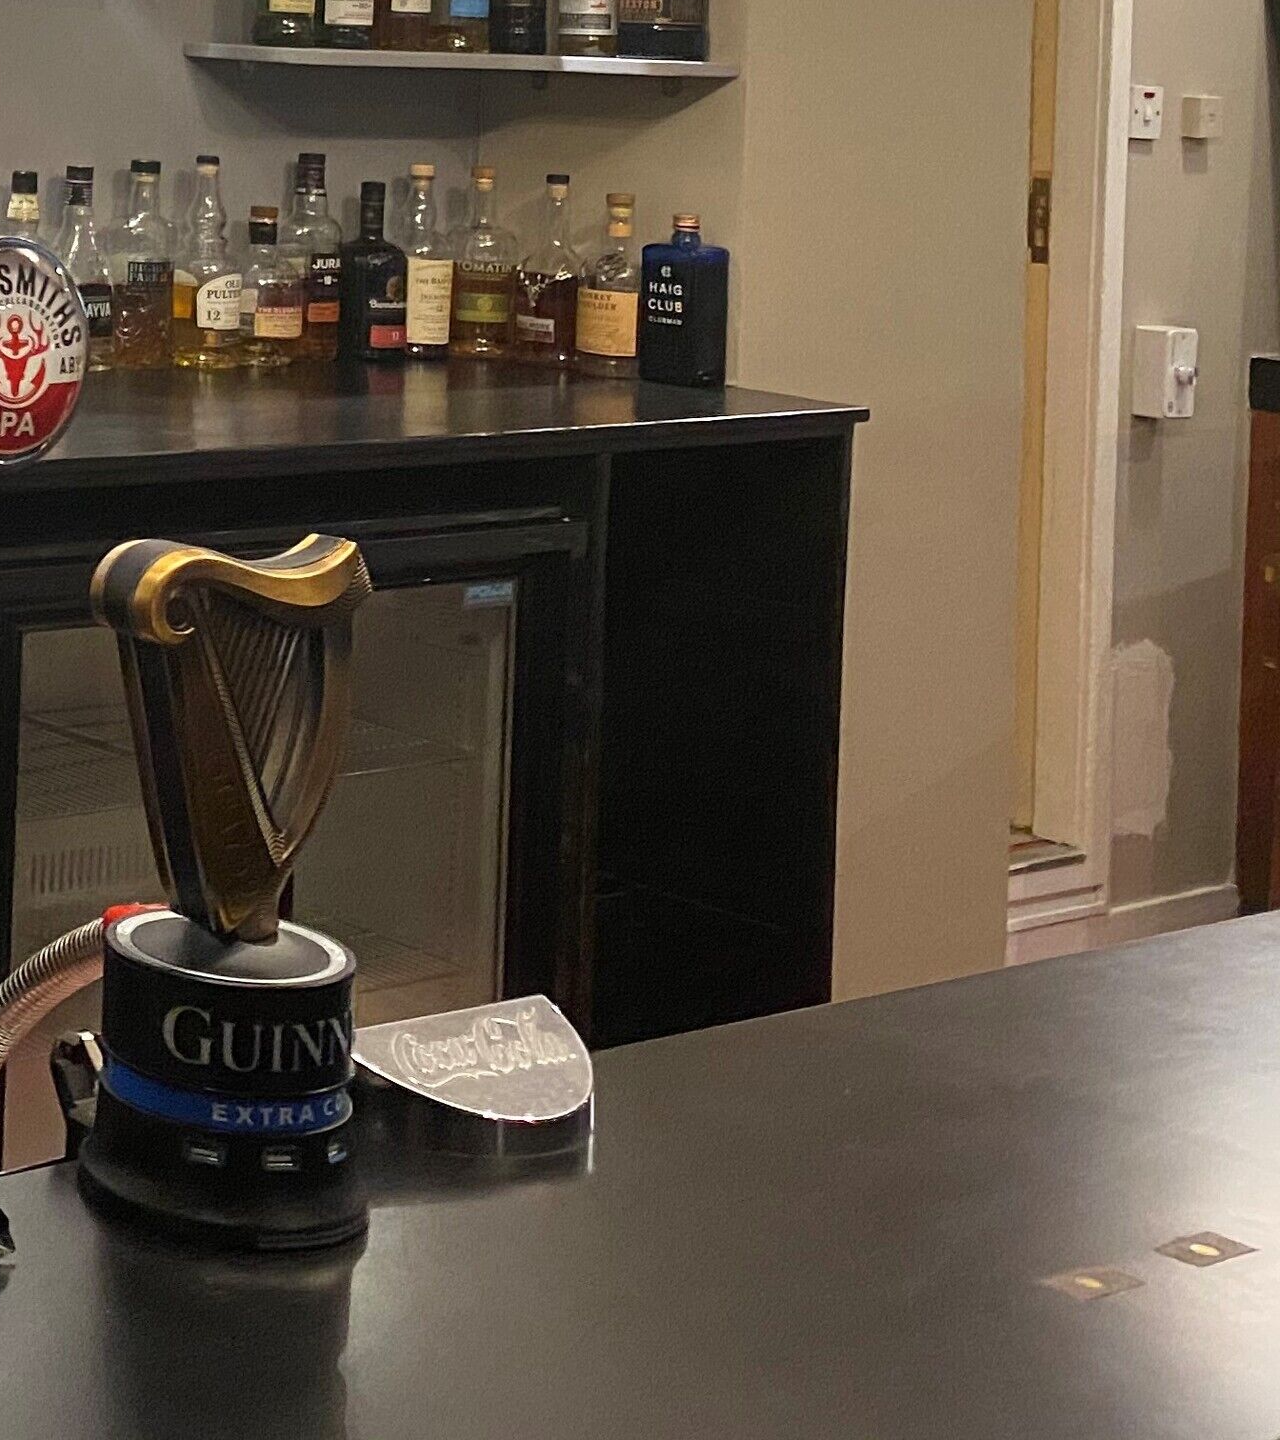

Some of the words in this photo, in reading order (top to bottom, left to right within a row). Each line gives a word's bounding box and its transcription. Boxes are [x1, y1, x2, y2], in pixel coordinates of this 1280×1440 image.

[312, 258, 340, 270] JURA
[649, 281, 683, 296] HAIG
[647, 298, 683, 313] CLUB
[206, 310, 221, 321] 12
[162, 1004, 354, 1074] GUINN
[212, 1101, 314, 1127] EXTRA
